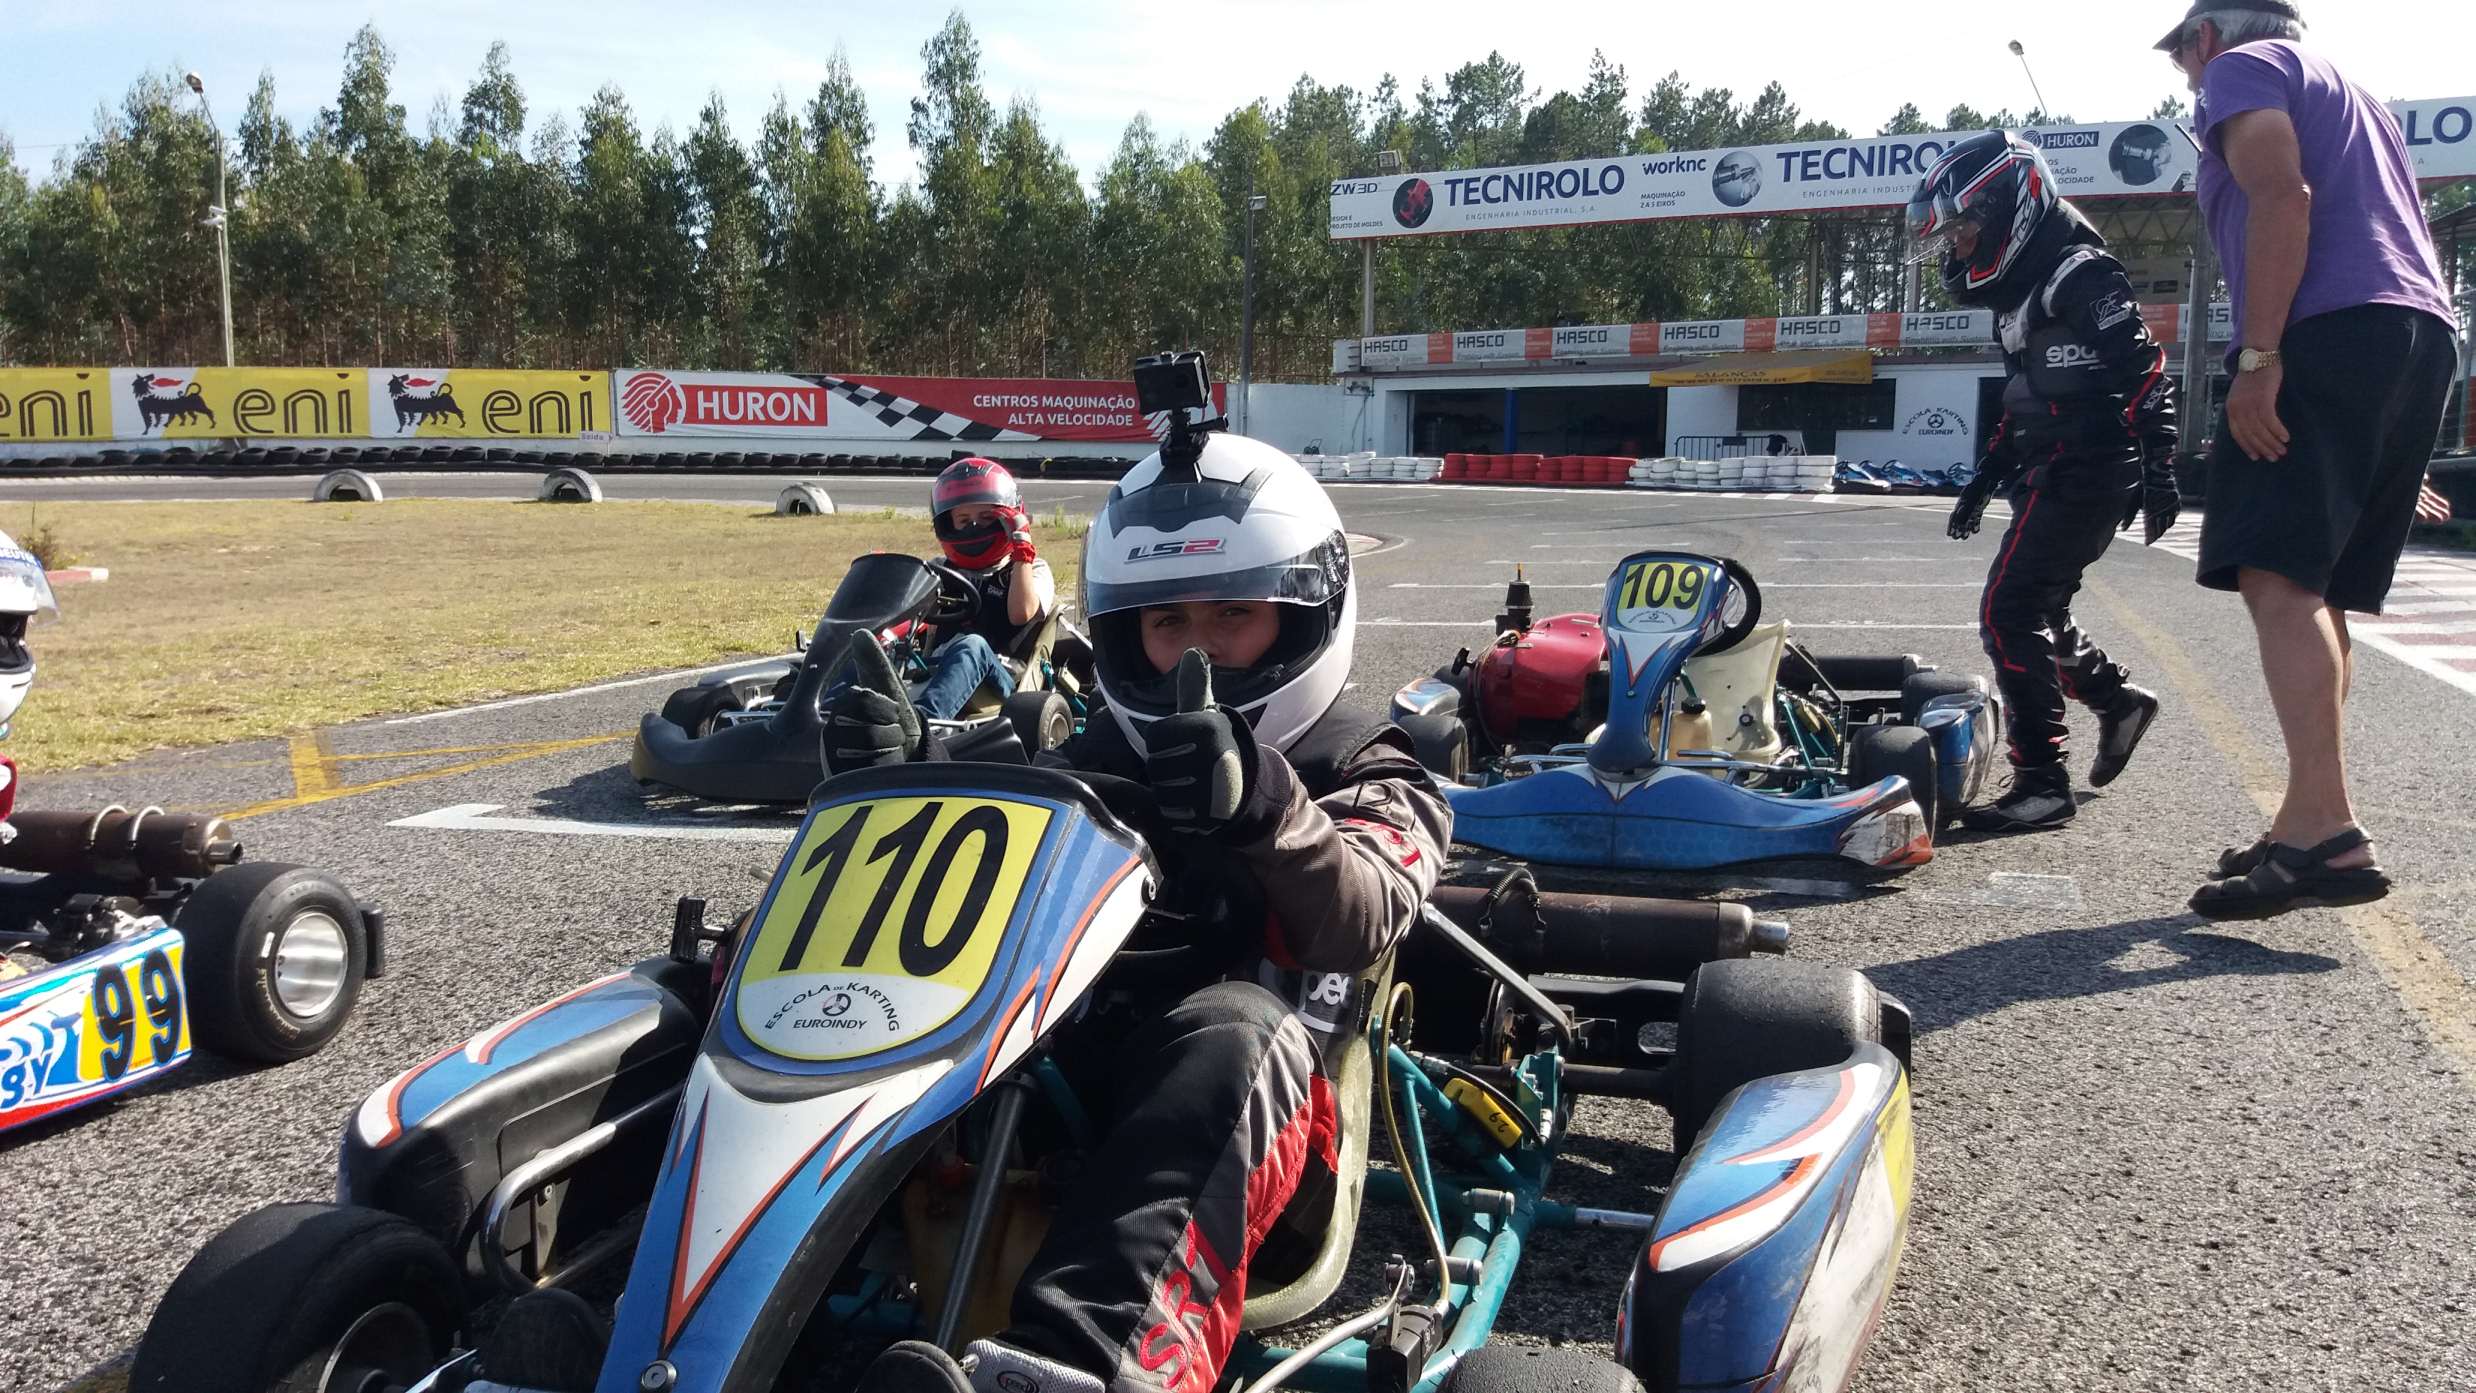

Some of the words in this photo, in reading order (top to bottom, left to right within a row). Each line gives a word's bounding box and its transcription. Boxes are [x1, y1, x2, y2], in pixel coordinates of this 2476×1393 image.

[2392, 106, 2473, 146] LO
[2047, 133, 2095, 147] HURON
[1642, 155, 1707, 175] worknc
[1776, 141, 1956, 183] TECNIRO
[1444, 164, 1625, 207] TECNIROLO
[1557, 330, 1608, 345] HASCO
[1665, 325, 1720, 340] HASCO
[1781, 320, 1841, 336] HASCO
[1364, 339, 1408, 354] HASCO
[1457, 334, 1505, 349] HASCO
[233, 373, 352, 434] eni
[481, 374, 594, 434] eni
[697, 391, 816, 422] HURON
[973, 394, 1039, 408] CENTROS
[1042, 394, 1136, 411] MAQUINAÇÃO
[1008, 413, 1045, 425] ALTA
[1047, 413, 1134, 426] VELOCIDADE
[1127, 539, 1221, 561] LS2
[1625, 563, 1704, 610] 109
[778, 801, 1010, 978] 110
[91, 947, 182, 1084] 99
[765, 983, 831, 1030] ESCOLA
[846, 982, 900, 1032] KARTING
[793, 1019, 868, 1030] EUROINDY
